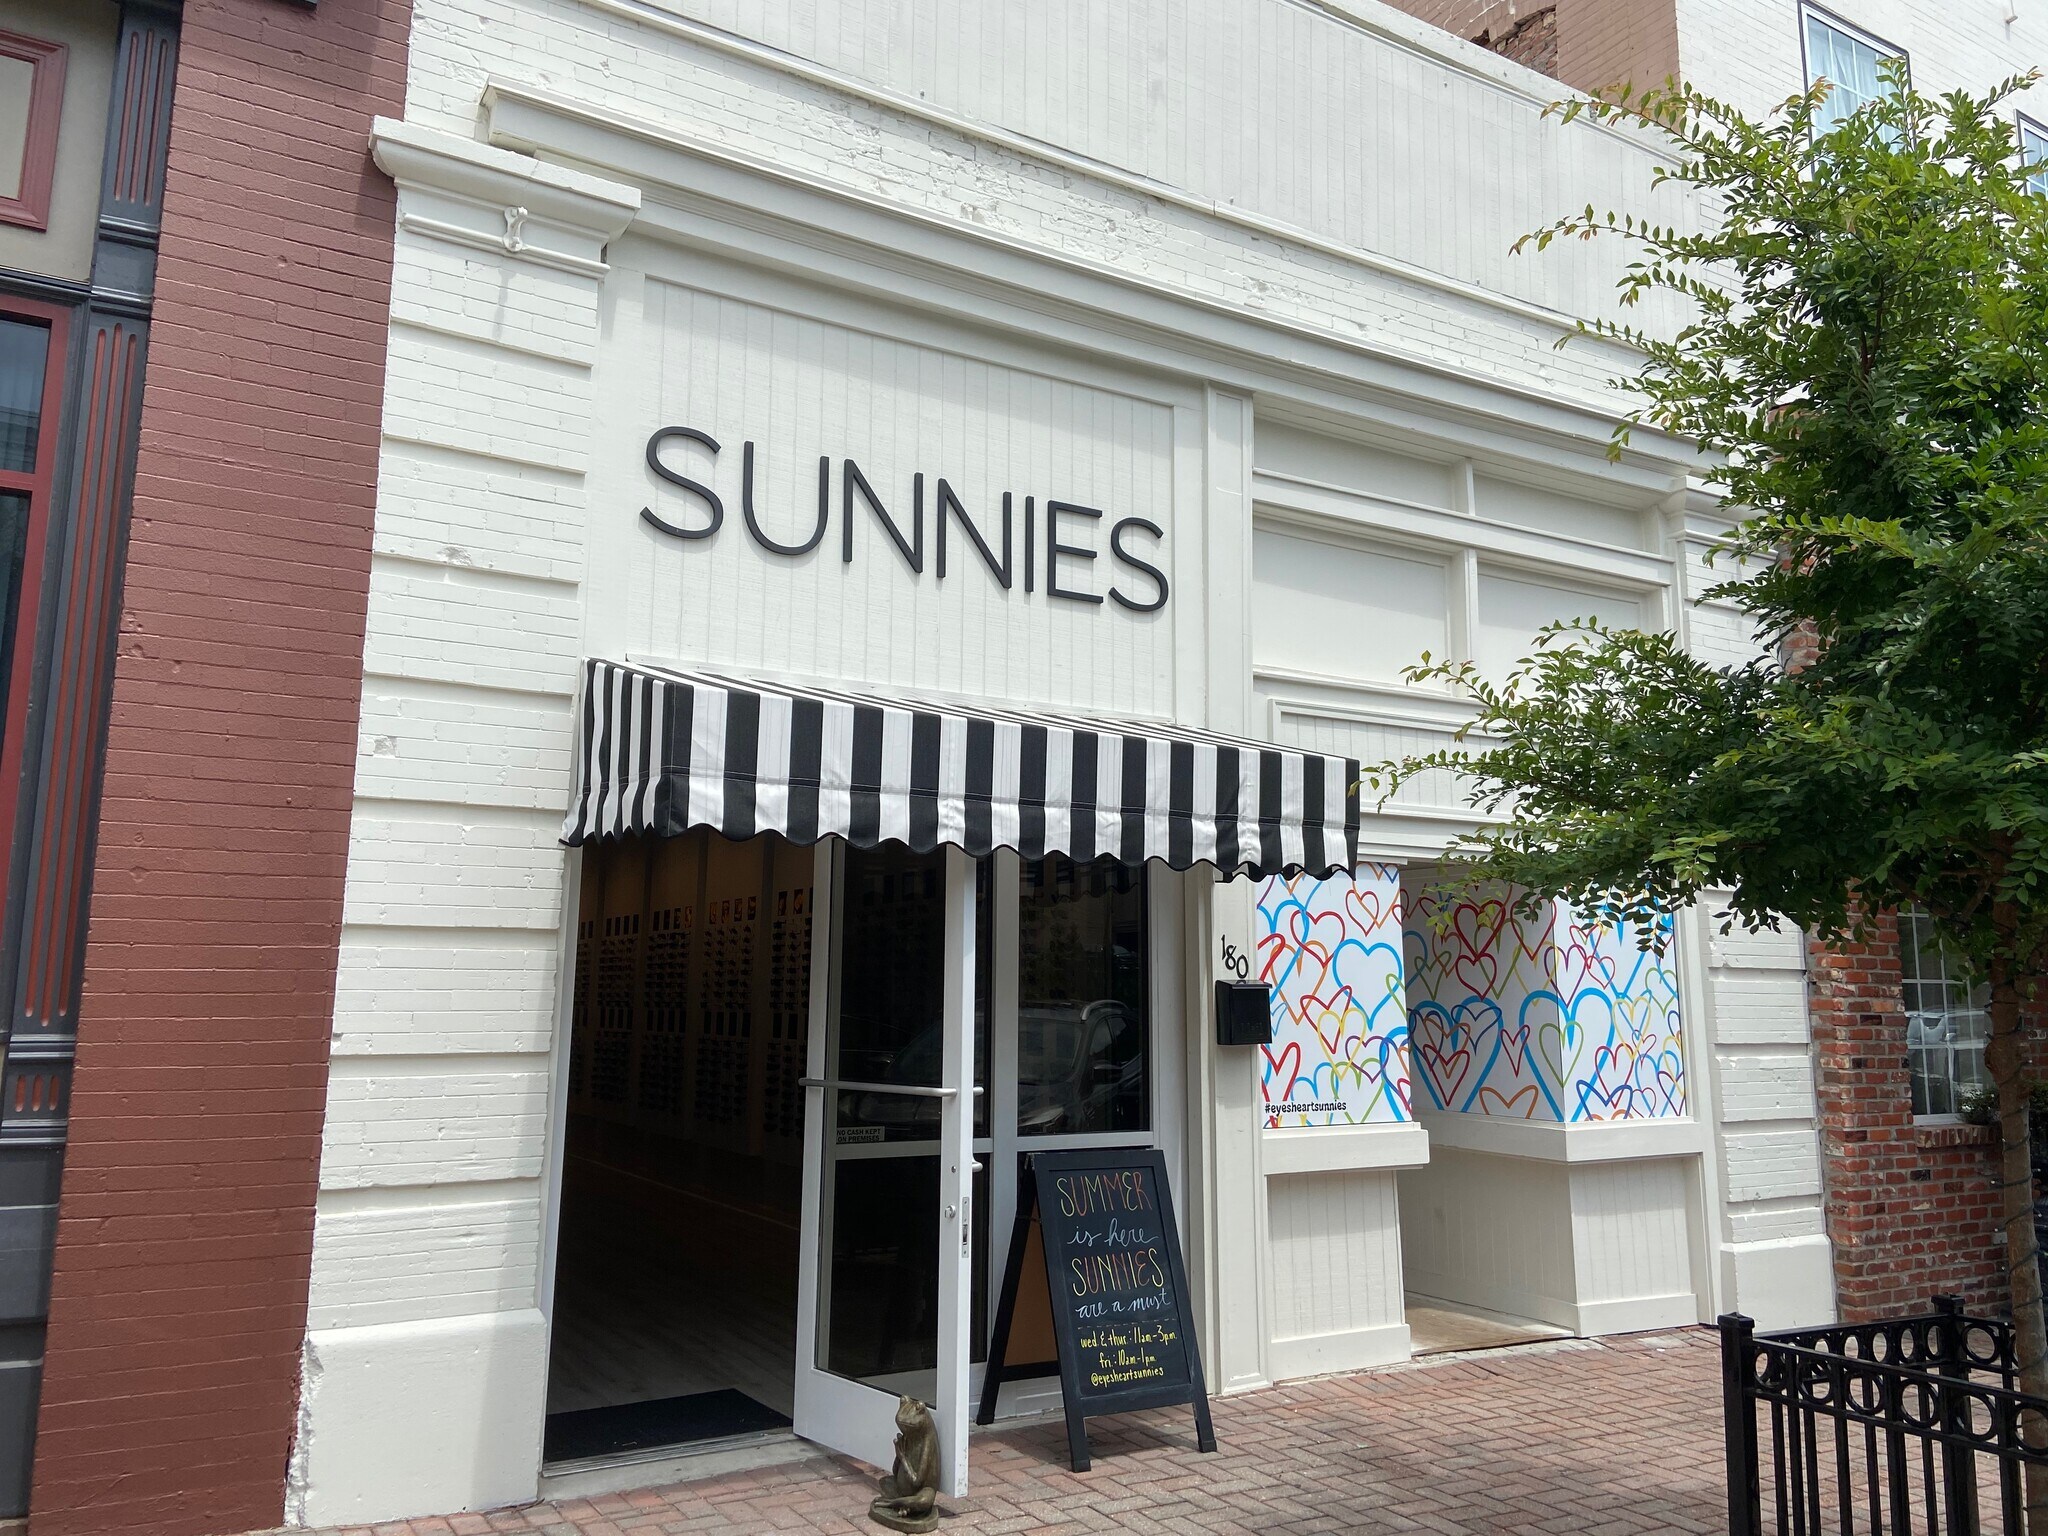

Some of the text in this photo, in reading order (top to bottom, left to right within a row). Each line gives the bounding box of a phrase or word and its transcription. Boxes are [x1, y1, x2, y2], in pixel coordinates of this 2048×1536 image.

[639, 425, 1169, 613] SUNNIES
[1221, 934, 1249, 979] 180
[1265, 1100, 1346, 1116] #eyesheartsunnies
[1056, 1171, 1152, 1217] SUMMER
[1067, 1218, 1159, 1247] is here
[1072, 1248, 1164, 1296] SUNNIES
[1076, 1288, 1172, 1319] are a must
[1100, 1331, 1107, 1347] &
[1091, 1367, 1164, 1388] @eyesheartsunnies
